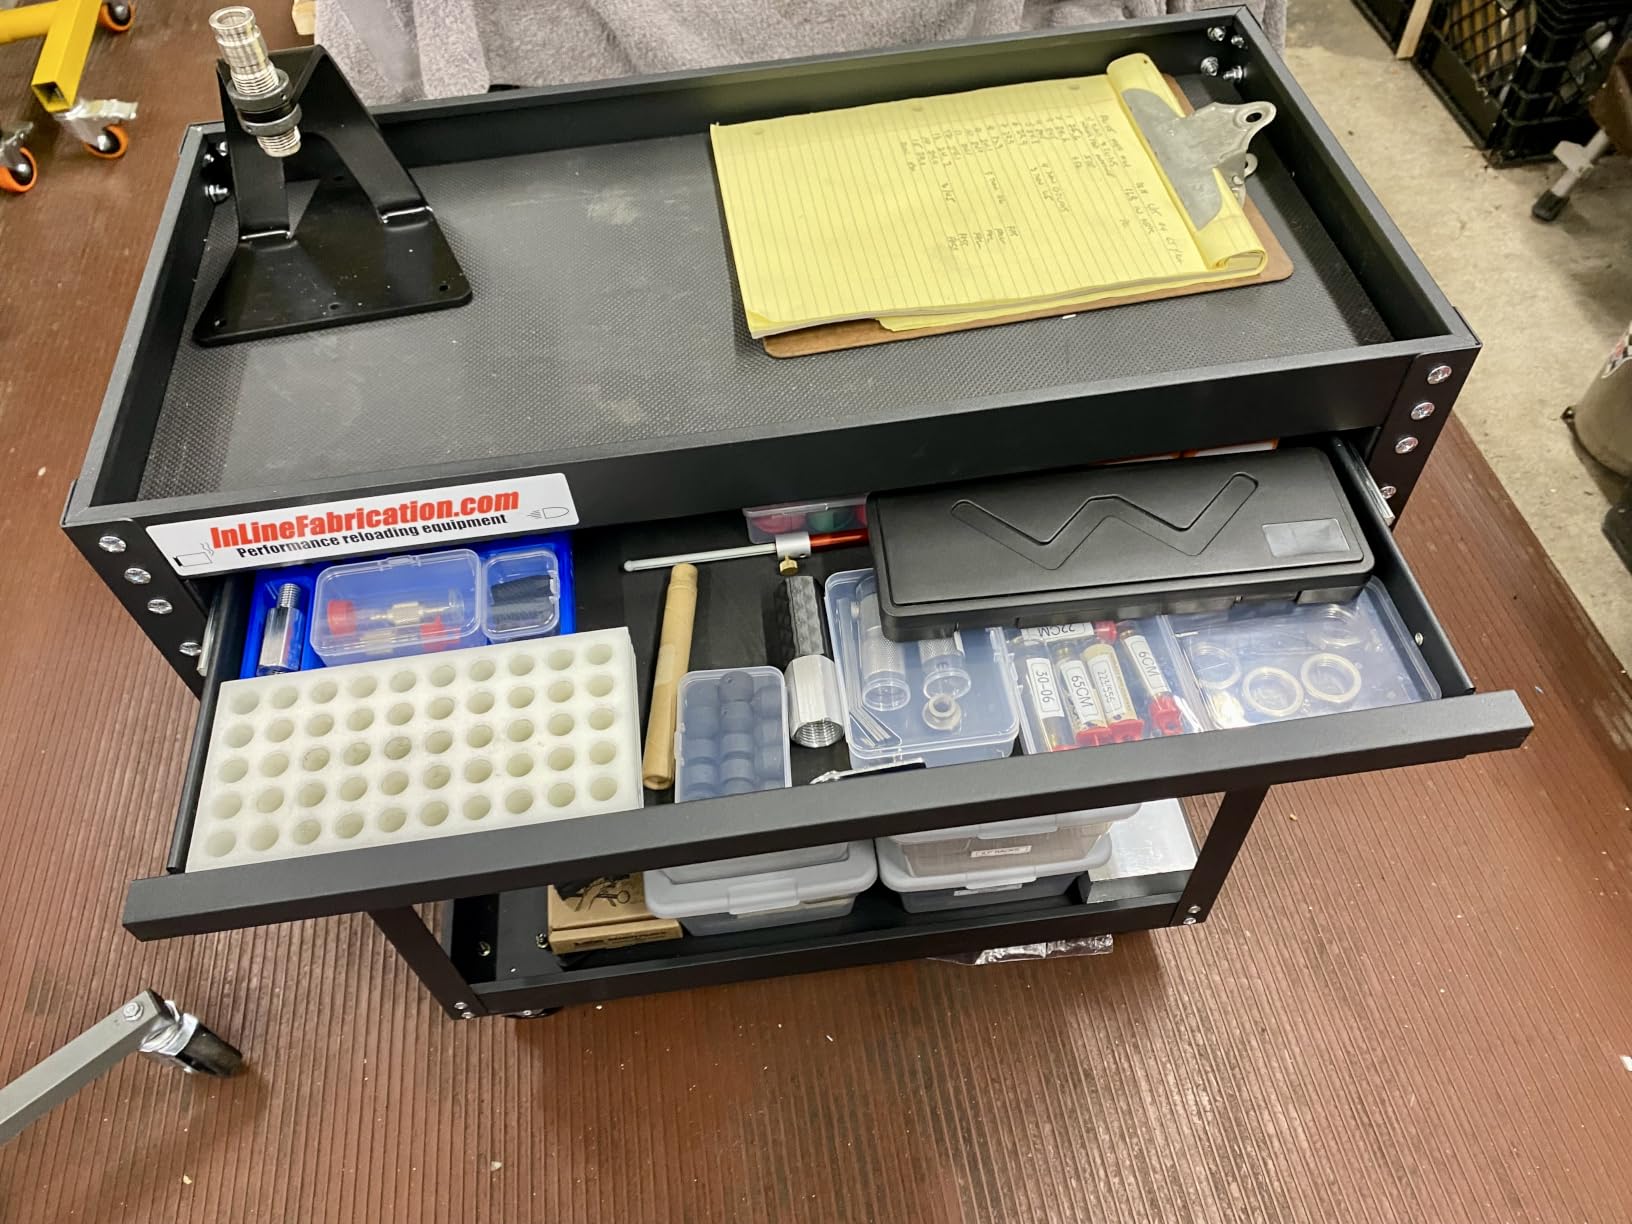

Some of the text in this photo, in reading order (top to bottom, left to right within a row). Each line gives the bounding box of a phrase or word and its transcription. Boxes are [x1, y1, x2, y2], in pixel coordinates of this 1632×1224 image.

[210, 491, 520, 549] InLineFabrication.com
[236, 514, 508, 558] Performance reloading equipment
[1138, 651, 1160, 677] 6CM
[1035, 670, 1054, 703] 30-06
[1071, 674, 1094, 709] 65CM
